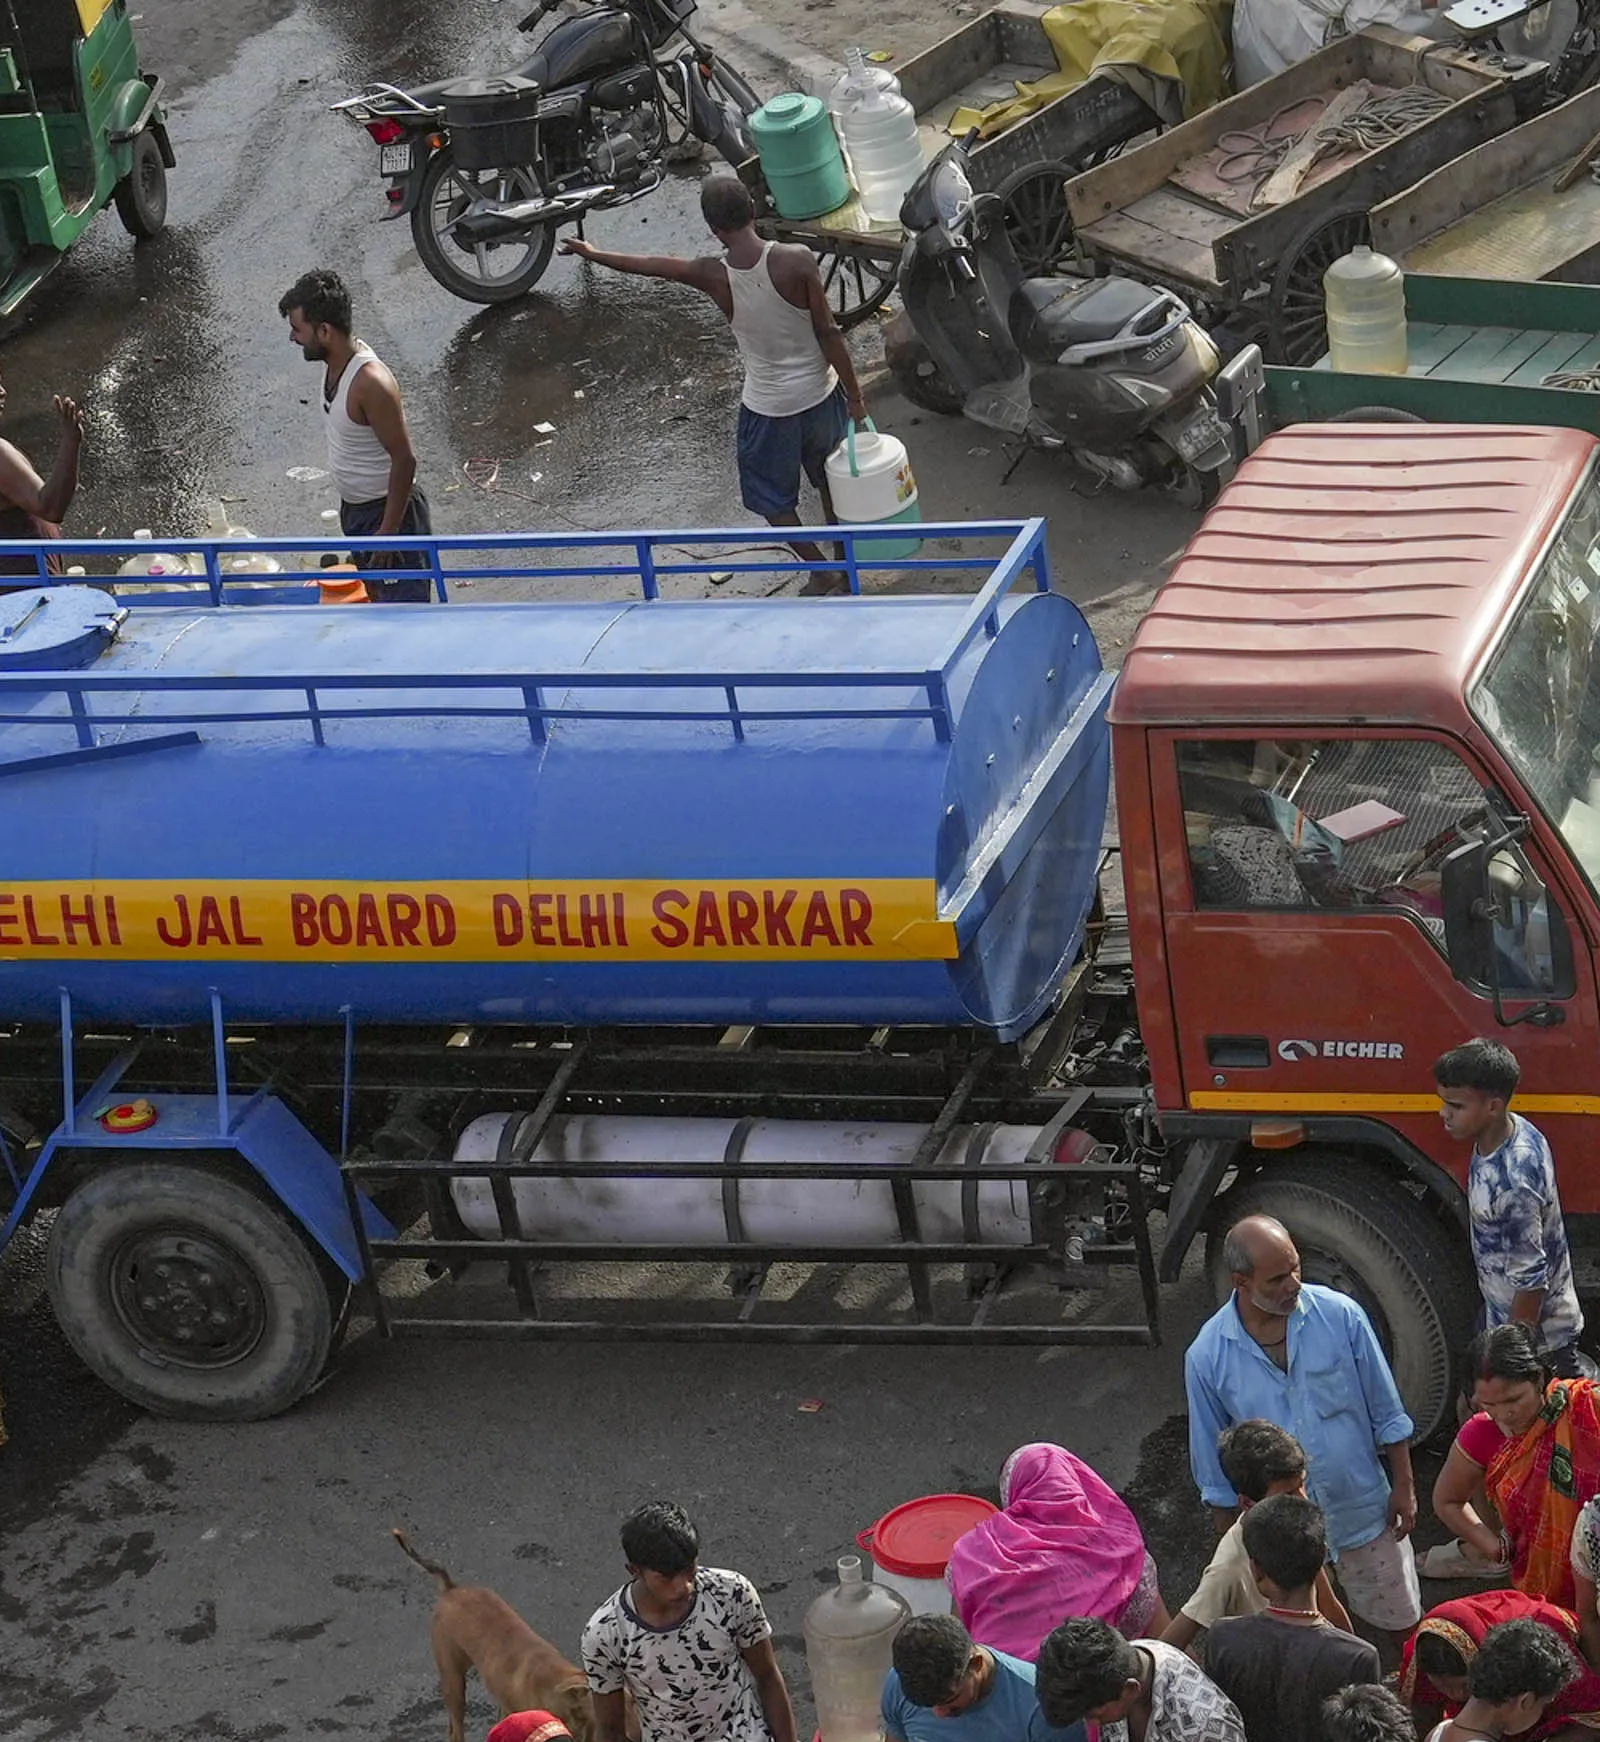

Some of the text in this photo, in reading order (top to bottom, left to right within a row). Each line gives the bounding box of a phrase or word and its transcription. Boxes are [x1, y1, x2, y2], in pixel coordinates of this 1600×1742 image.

[157, 895, 263, 947] JAL
[291, 893, 457, 947] BOARD
[493, 891, 629, 948] DELHI
[651, 889, 873, 948] SARKAR
[1323, 1041, 1404, 1059] EICHER
